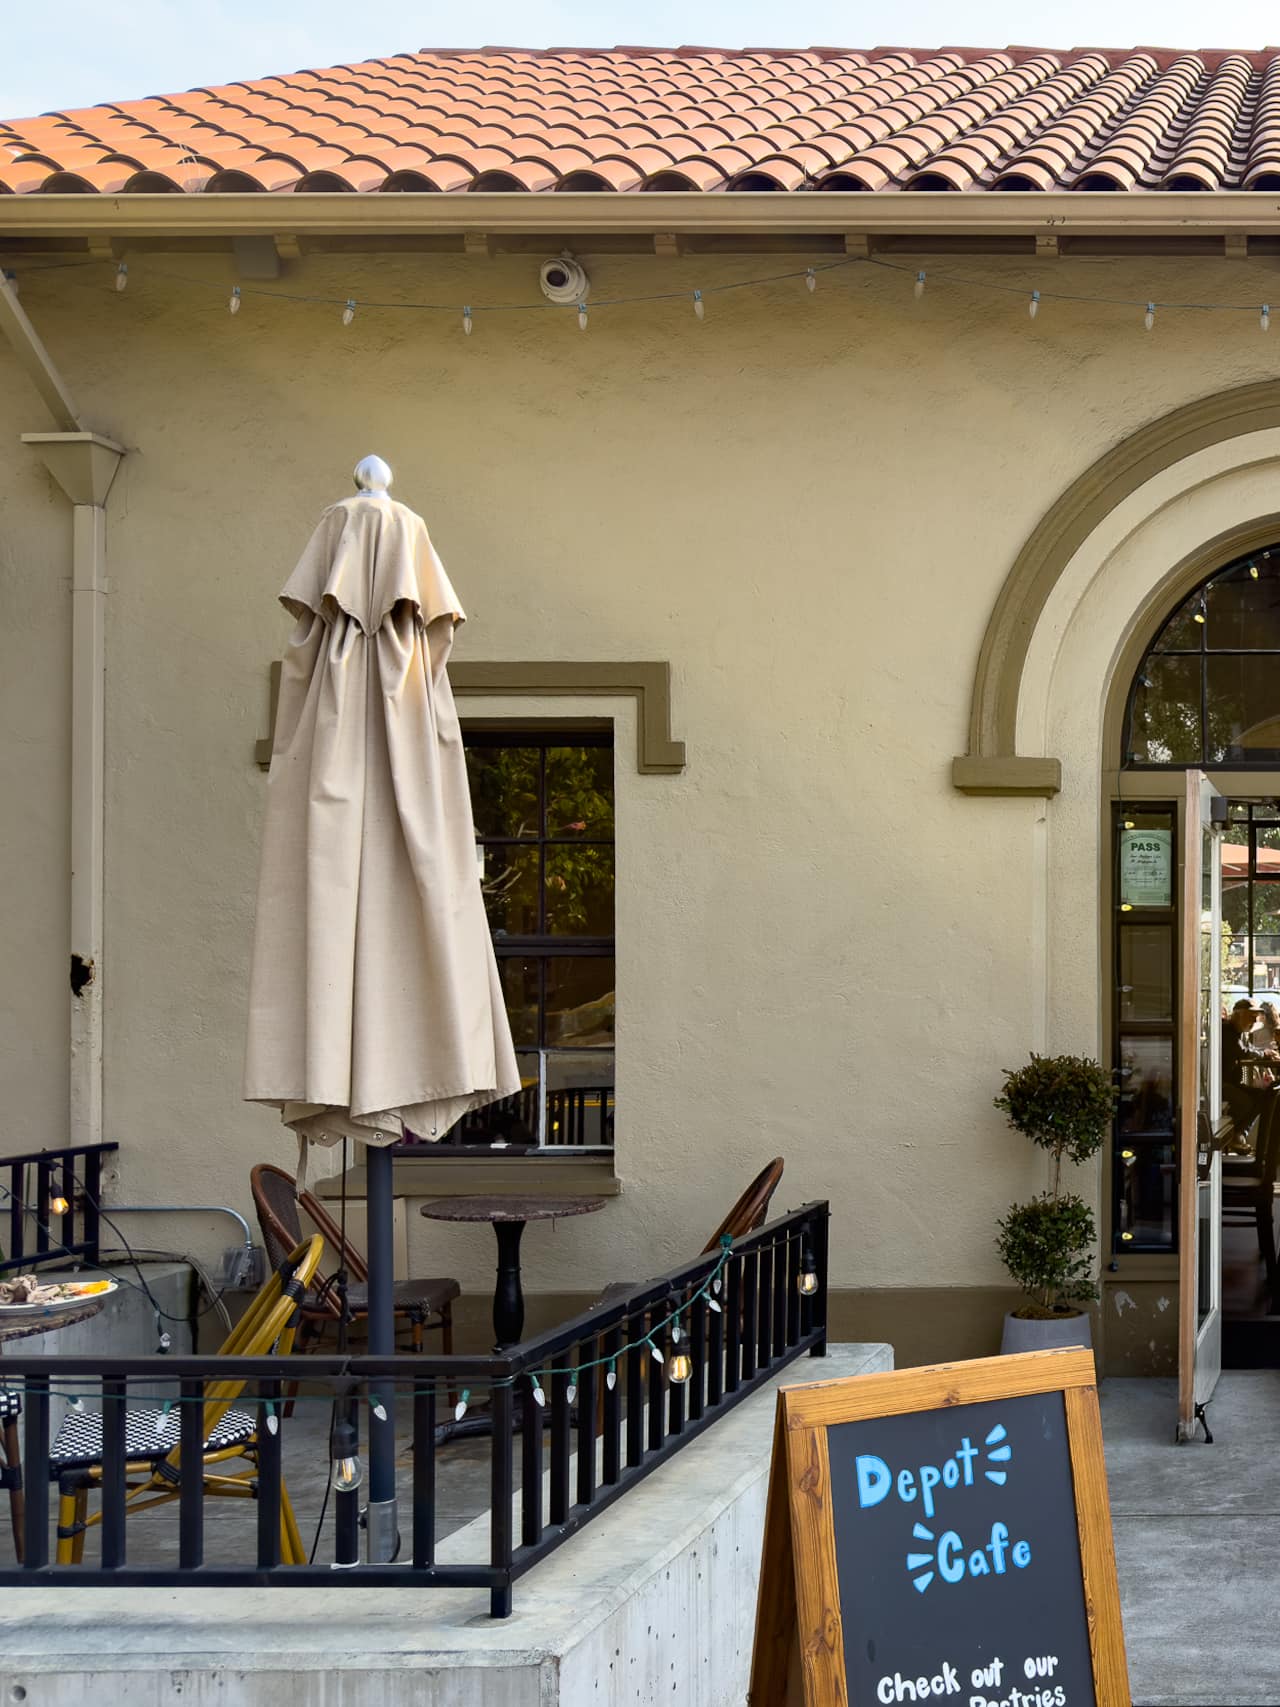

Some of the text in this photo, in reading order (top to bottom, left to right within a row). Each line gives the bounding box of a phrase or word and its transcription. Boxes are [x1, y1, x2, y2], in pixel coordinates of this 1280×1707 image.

[1130, 842, 1161, 851] PASS
[856, 1437, 979, 1517] Depot
[937, 1522, 1032, 1583] Cafe
[877, 1656, 1059, 1704] Check out our
